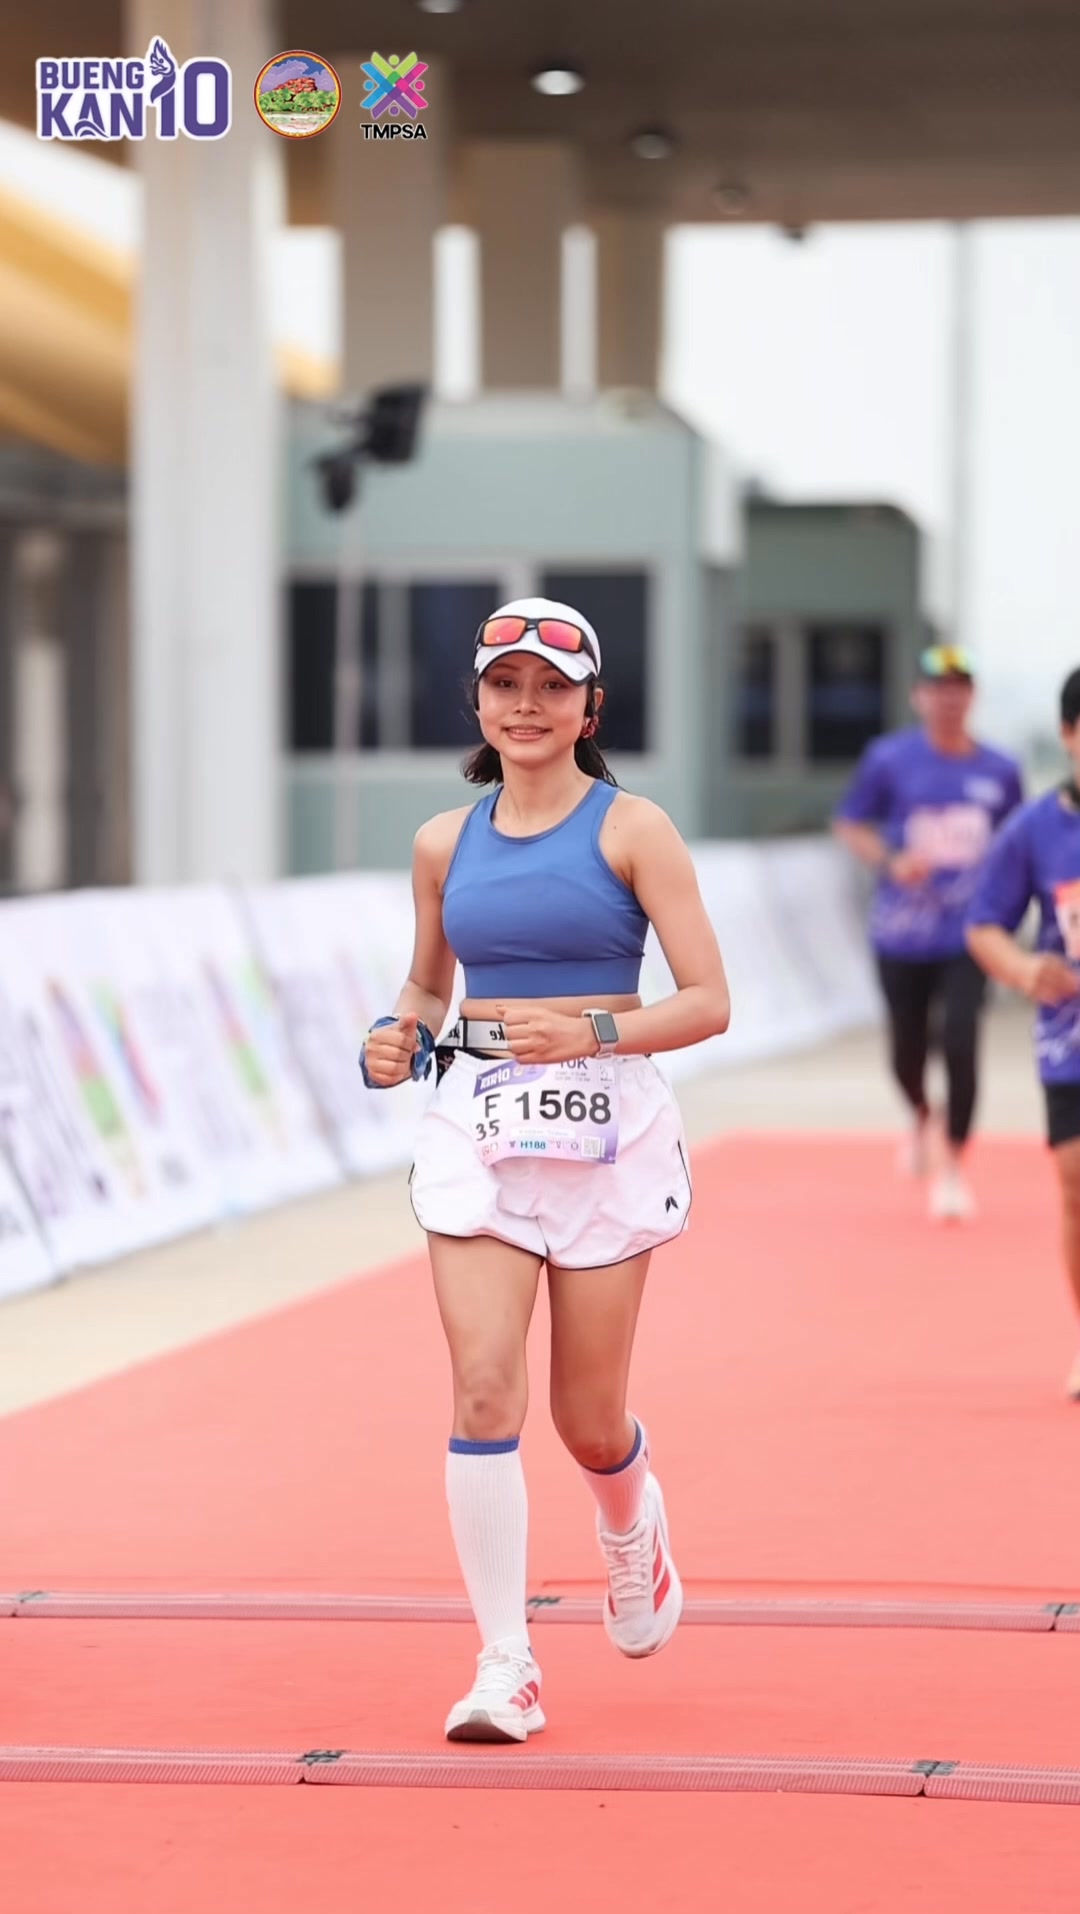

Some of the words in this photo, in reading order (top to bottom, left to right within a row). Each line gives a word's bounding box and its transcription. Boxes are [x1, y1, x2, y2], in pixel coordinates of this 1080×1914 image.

[485, 1093, 501, 1119] F
[514, 1089, 611, 1125] 1568
[475, 1119, 500, 1141] 35
[520, 1141, 546, 1150] H188
